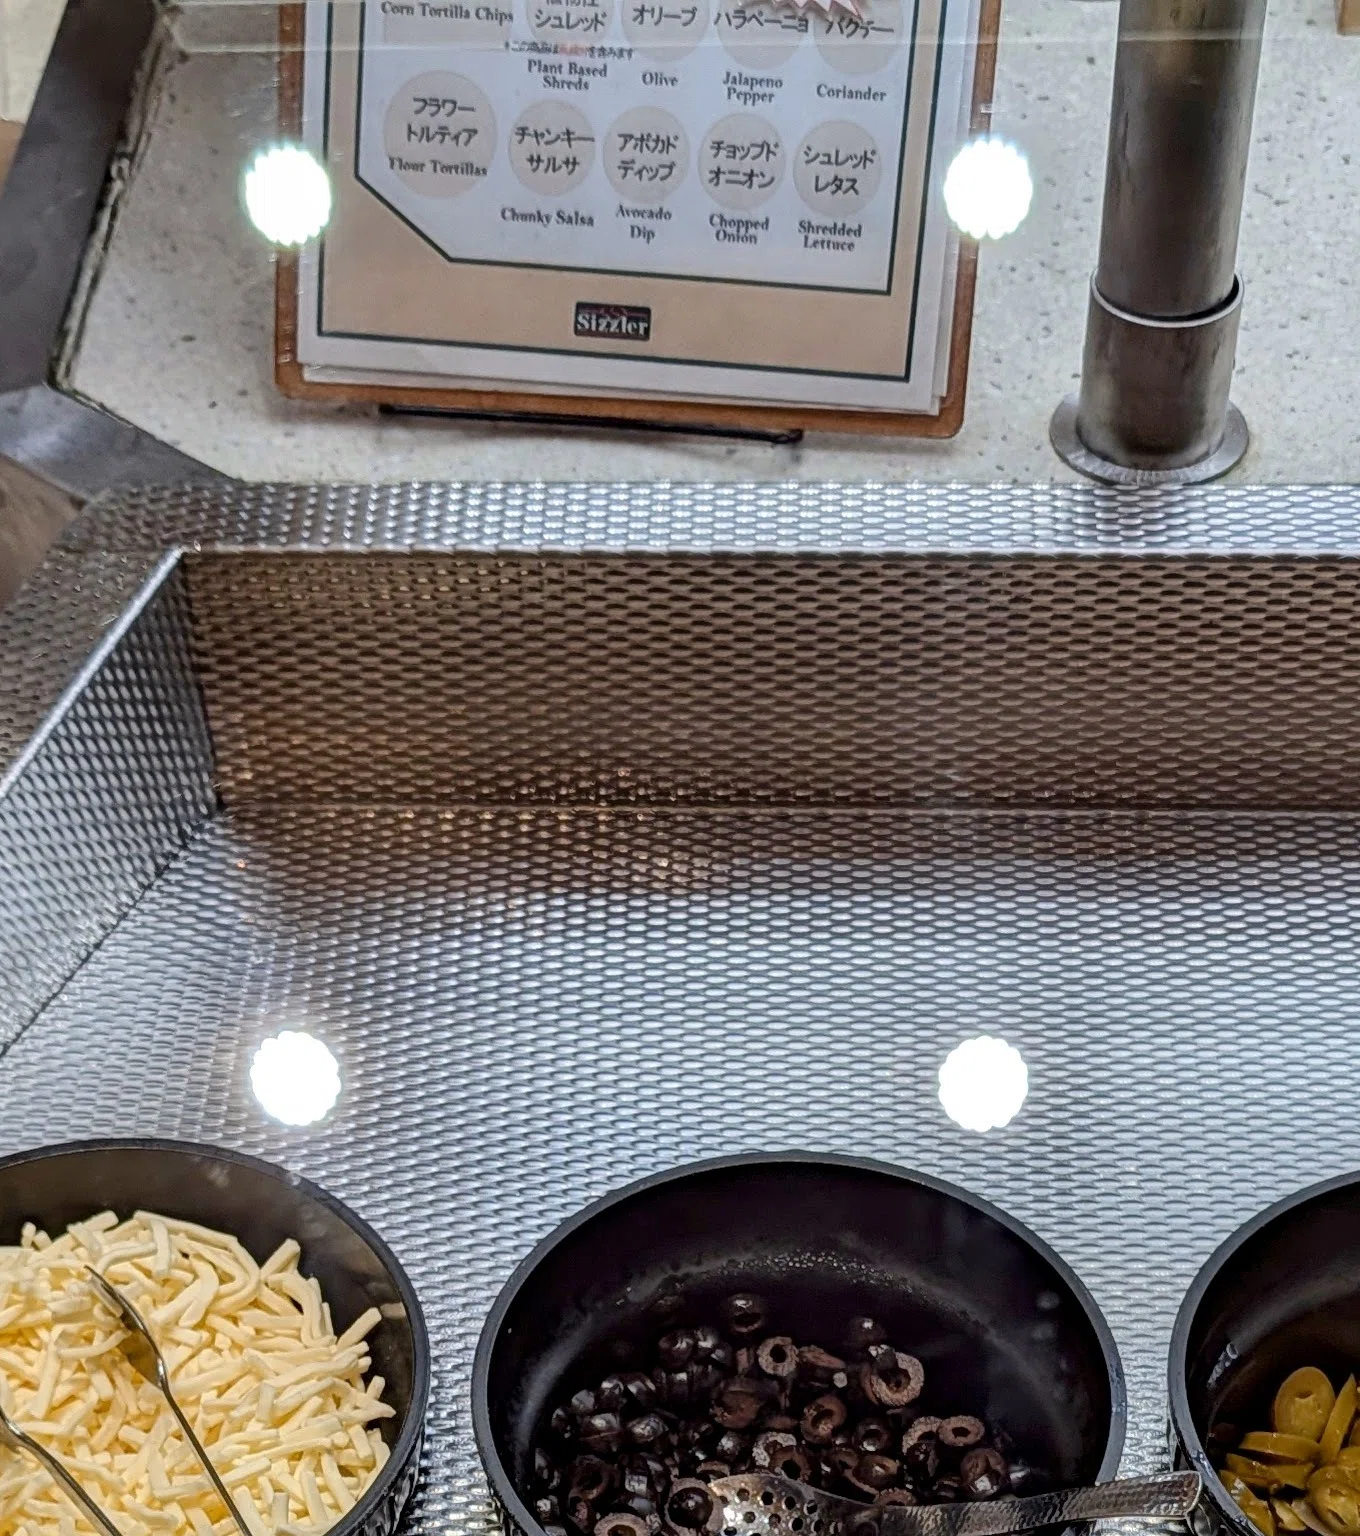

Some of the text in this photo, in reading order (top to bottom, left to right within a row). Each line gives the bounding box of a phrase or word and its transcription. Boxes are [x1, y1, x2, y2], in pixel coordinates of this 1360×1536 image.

[381, 1, 514, 27] Corn Tortilla Chips
[534, 10, 608, 32] シュレッド
[714, 9, 809, 33] ハラペーニョ
[527, 59, 608, 77] Plant Based
[542, 75, 590, 90] Shreds
[641, 72, 678, 87] Olive
[726, 87, 775, 106] Pepper
[816, 84, 887, 101] Coriander
[412, 98, 476, 117] フラワー
[406, 123, 479, 147] トルティア
[514, 126, 596, 148] チャンキー
[617, 132, 680, 155] アボカド
[709, 140, 780, 162] チョップド
[803, 146, 877, 170] シュレッド
[388, 155, 488, 177] Flour Tortillas
[526, 154, 580, 176] サルサ
[617, 159, 677, 181] ディップ
[708, 168, 775, 190] オニオン
[814, 174, 860, 196] レタス
[500, 207, 595, 228] Chunky Salsa
[615, 204, 673, 221] Avocado
[709, 213, 770, 233] Chopped
[630, 225, 656, 244] Dip
[715, 229, 758, 245] Onion
[798, 219, 863, 238] Shredded
[803, 235, 855, 252] Lettuce
[576, 313, 649, 336] Sizzler
